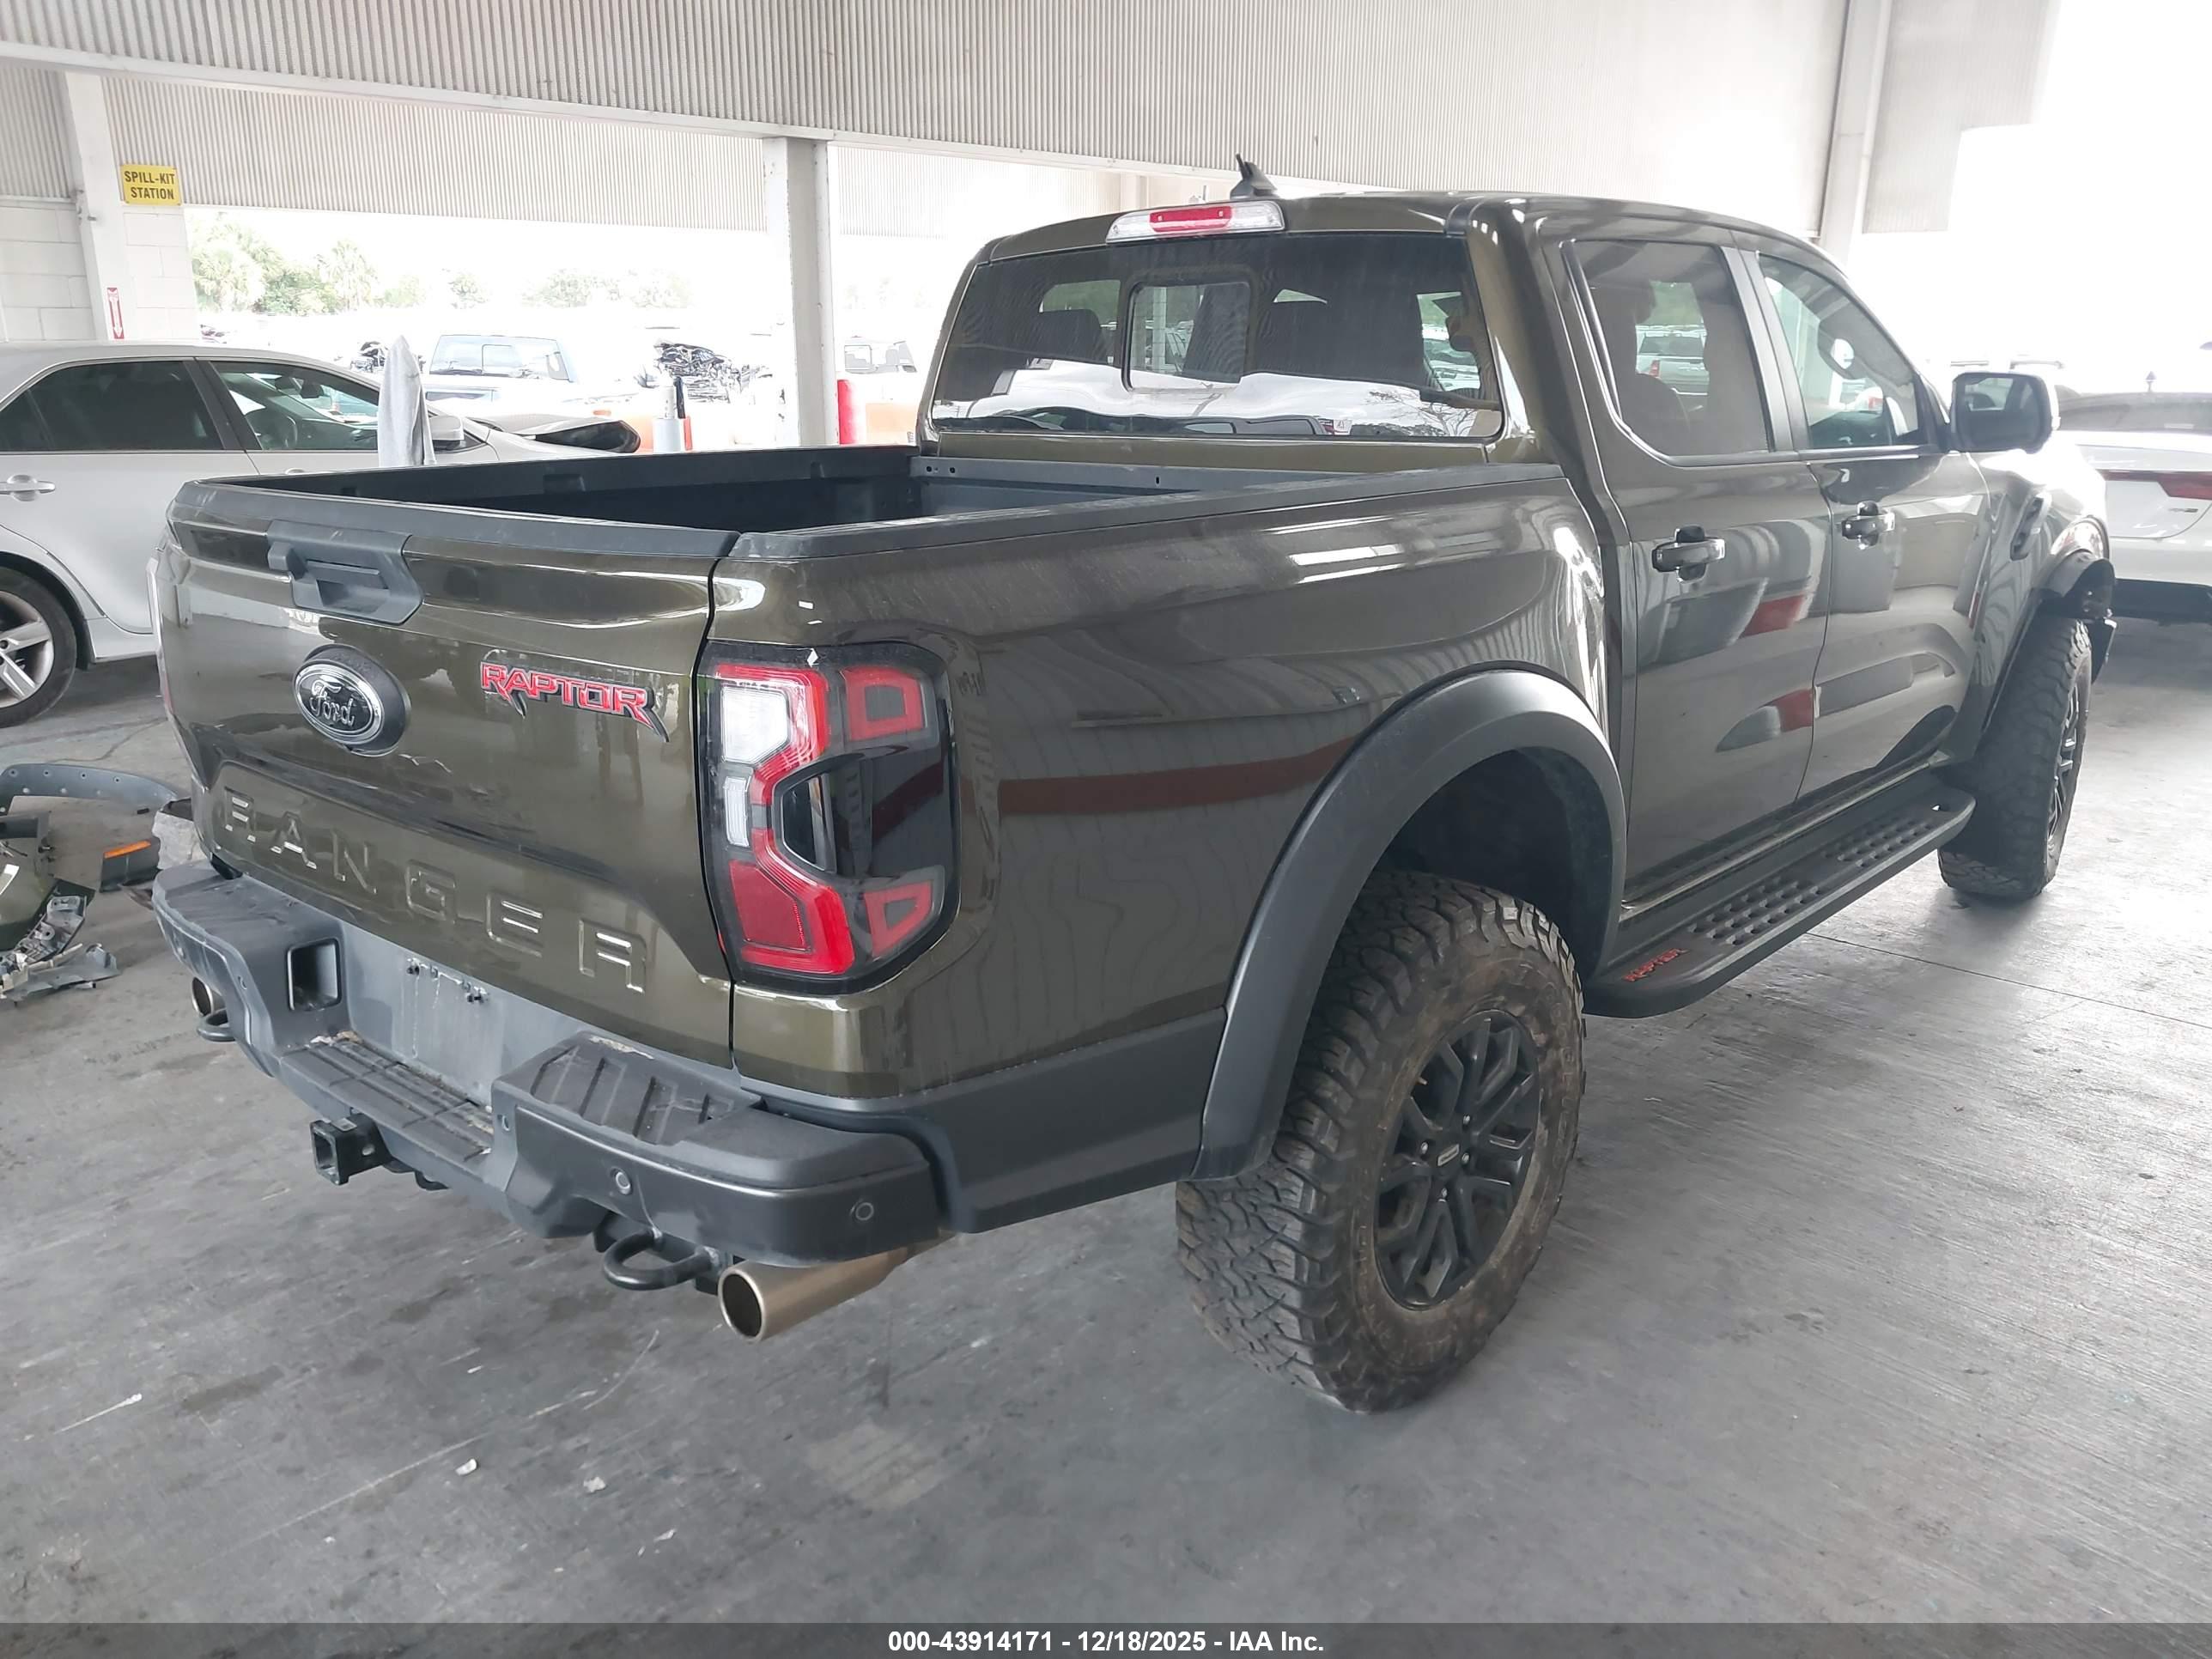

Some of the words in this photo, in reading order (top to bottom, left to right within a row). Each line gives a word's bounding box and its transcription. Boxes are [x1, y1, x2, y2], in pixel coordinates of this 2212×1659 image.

[124, 170, 175, 185] SPILL-KIT
[130, 186, 174, 200] STATION
[309, 678, 356, 727] Ford
[480, 660, 667, 741] RAPTOR
[223, 785, 647, 994] RANGER
